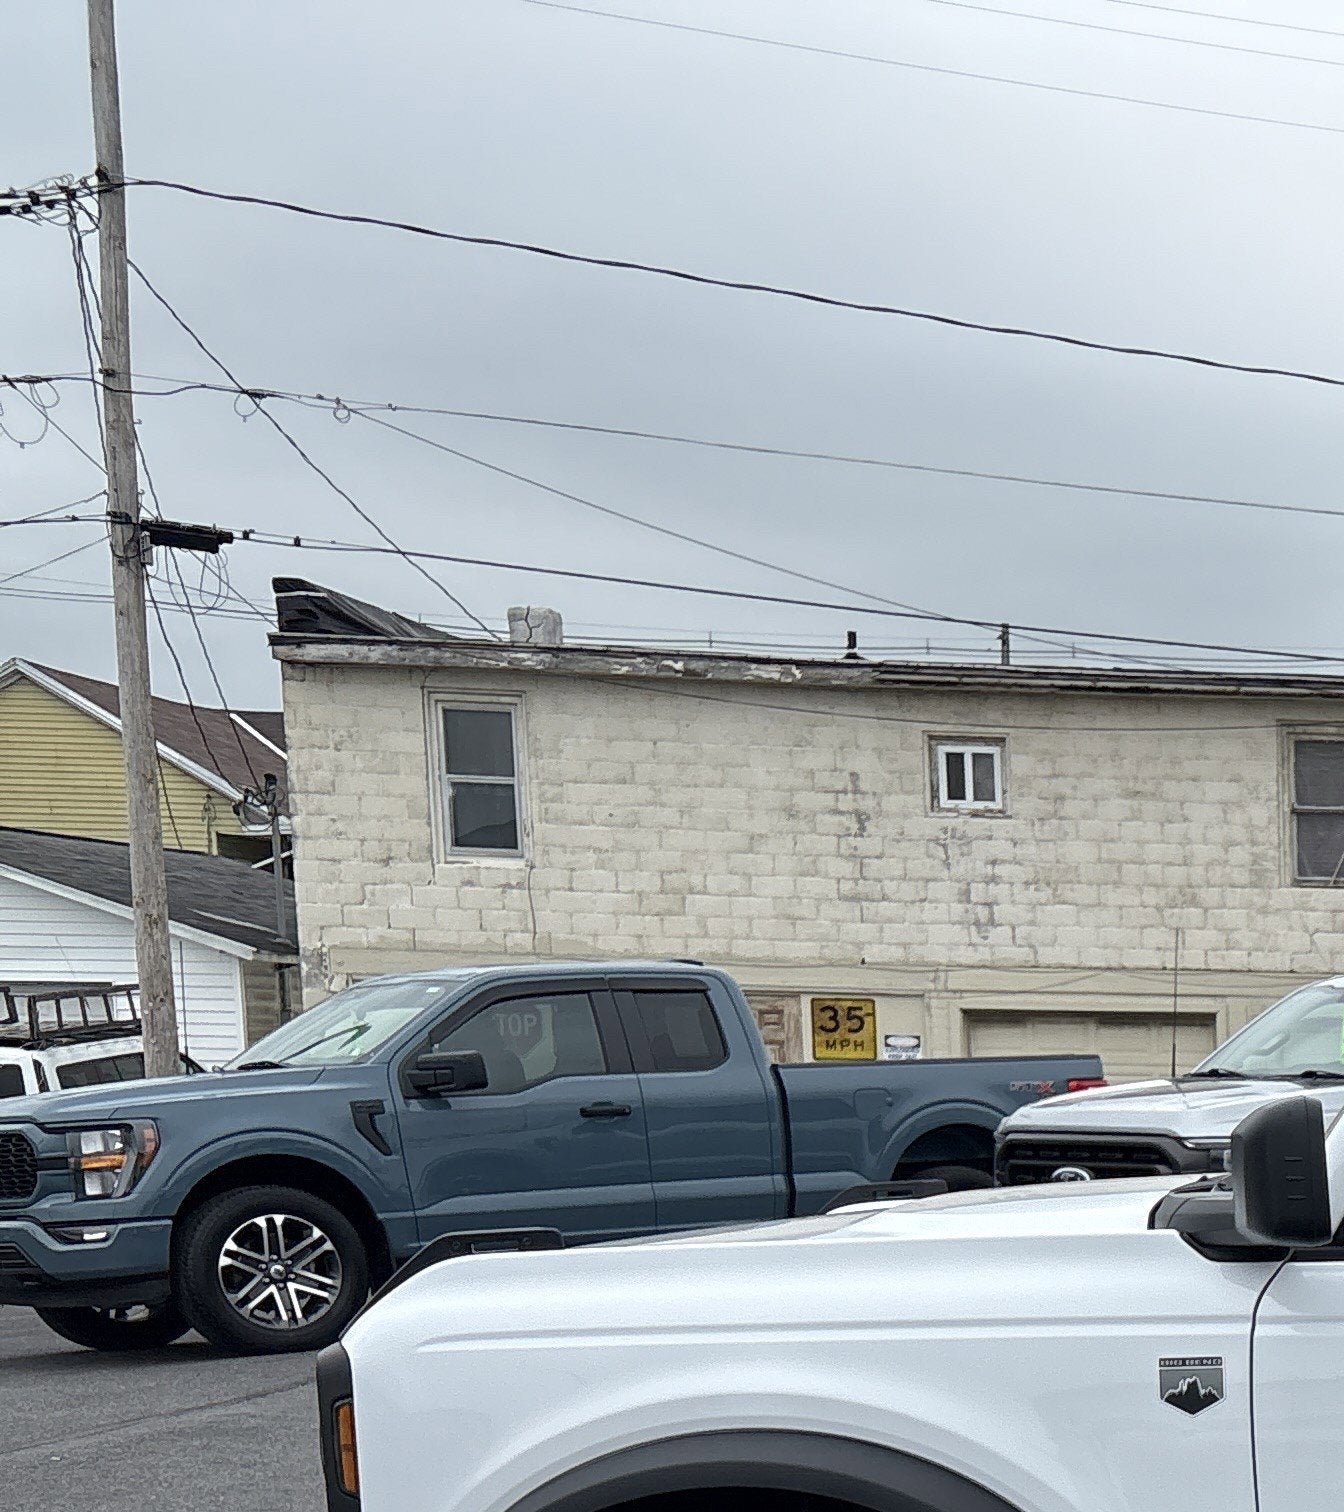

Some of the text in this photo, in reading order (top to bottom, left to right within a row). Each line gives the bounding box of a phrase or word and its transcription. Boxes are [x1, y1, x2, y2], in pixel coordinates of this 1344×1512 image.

[491, 1012, 539, 1038] TOP
[818, 1004, 866, 1034] 35
[824, 1039, 866, 1052] MPH
